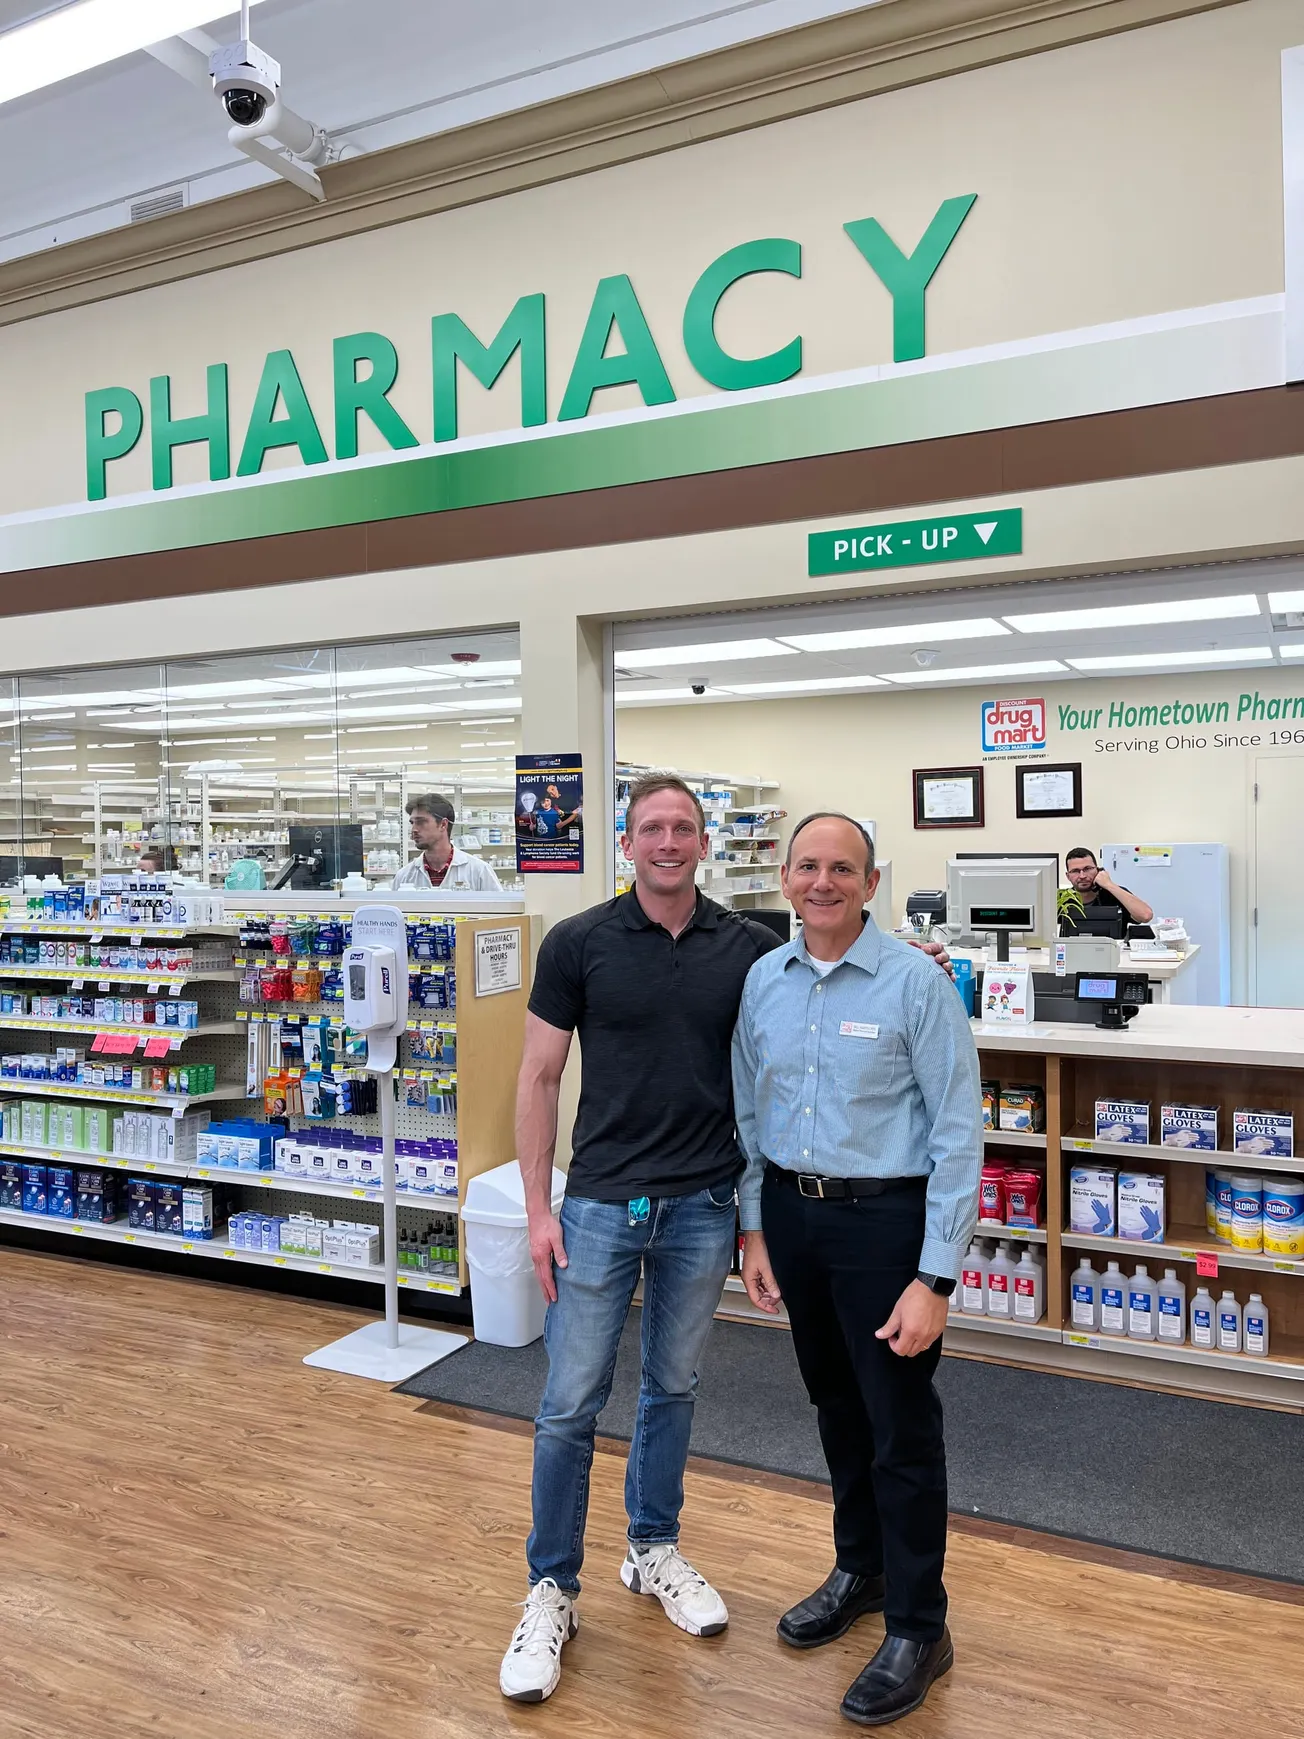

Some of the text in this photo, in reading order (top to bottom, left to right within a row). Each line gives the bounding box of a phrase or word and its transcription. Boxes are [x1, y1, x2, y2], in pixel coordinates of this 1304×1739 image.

[85, 192, 979, 501] PHARMACY
[833, 534, 893, 561] PICK
[921, 527, 959, 551] UP
[987, 707, 1033, 728] drug
[1058, 705, 1103, 730] Your
[1108, 699, 1230, 728] Hometown
[994, 724, 1045, 744] mart
[1095, 738, 1159, 754] Serving
[1166, 735, 1208, 750] Ohio
[1214, 732, 1261, 748] Since
[484, 934, 512, 944] PHARMACY
[490, 952, 508, 960] HOURS
[1109, 1105, 1136, 1114] LATEX
[1175, 1110, 1203, 1119] LATEX
[1097, 1112, 1134, 1123] GLOVES
[1249, 1116, 1279, 1125] LATEX
[1163, 1118, 1202, 1129] GLOVES
[1236, 1124, 1277, 1135] GLOVES
[1220, 1193, 1231, 1201] CLO
[1234, 1202, 1259, 1211] CLOROX
[1266, 1204, 1291, 1214] CLOROX
